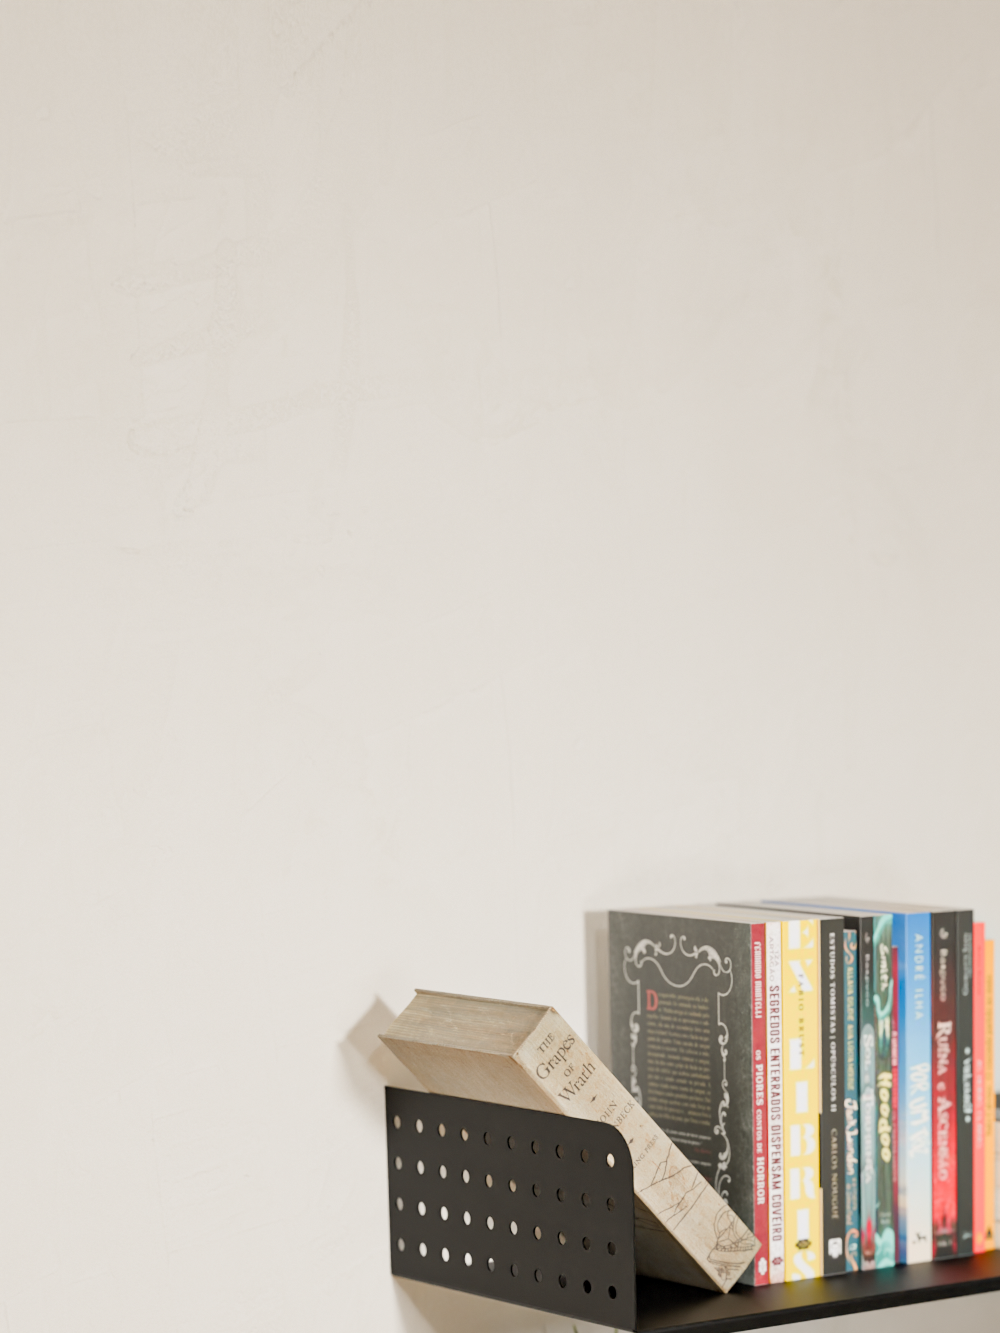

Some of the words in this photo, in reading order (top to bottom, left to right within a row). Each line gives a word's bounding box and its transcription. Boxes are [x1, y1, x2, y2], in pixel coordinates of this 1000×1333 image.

[828, 932, 836, 980] ESTUDOS
[914, 933, 926, 981] ANDRÉ
[769, 985, 780, 1043] SEGREDOS
[829, 981, 837, 1034] TOMISTAS
[914, 988, 924, 1020] ILHA
[536, 1032, 556, 1054] THE
[536, 1034, 576, 1080] Grapes
[557, 1061, 596, 1101] Wrath
[563, 1063, 575, 1077] OF
[755, 1063, 765, 1106] PIORES
[770, 1048, 781, 1121] ENTERRADOS
[909, 1062, 931, 1096] POR
[599, 1100, 618, 1123] OHN
[614, 1101, 635, 1127] NBECK
[877, 1071, 893, 1164] Hoodoo
[909, 1096, 931, 1126] UM
[770, 1125, 782, 1190] DISPENSAM
[788, 1037, 816, 1281] LIBRIS
[830, 1127, 839, 1170] CARLOS
[756, 1156, 766, 1205] HORROR
[771, 1194, 782, 1241] COVEIRO
